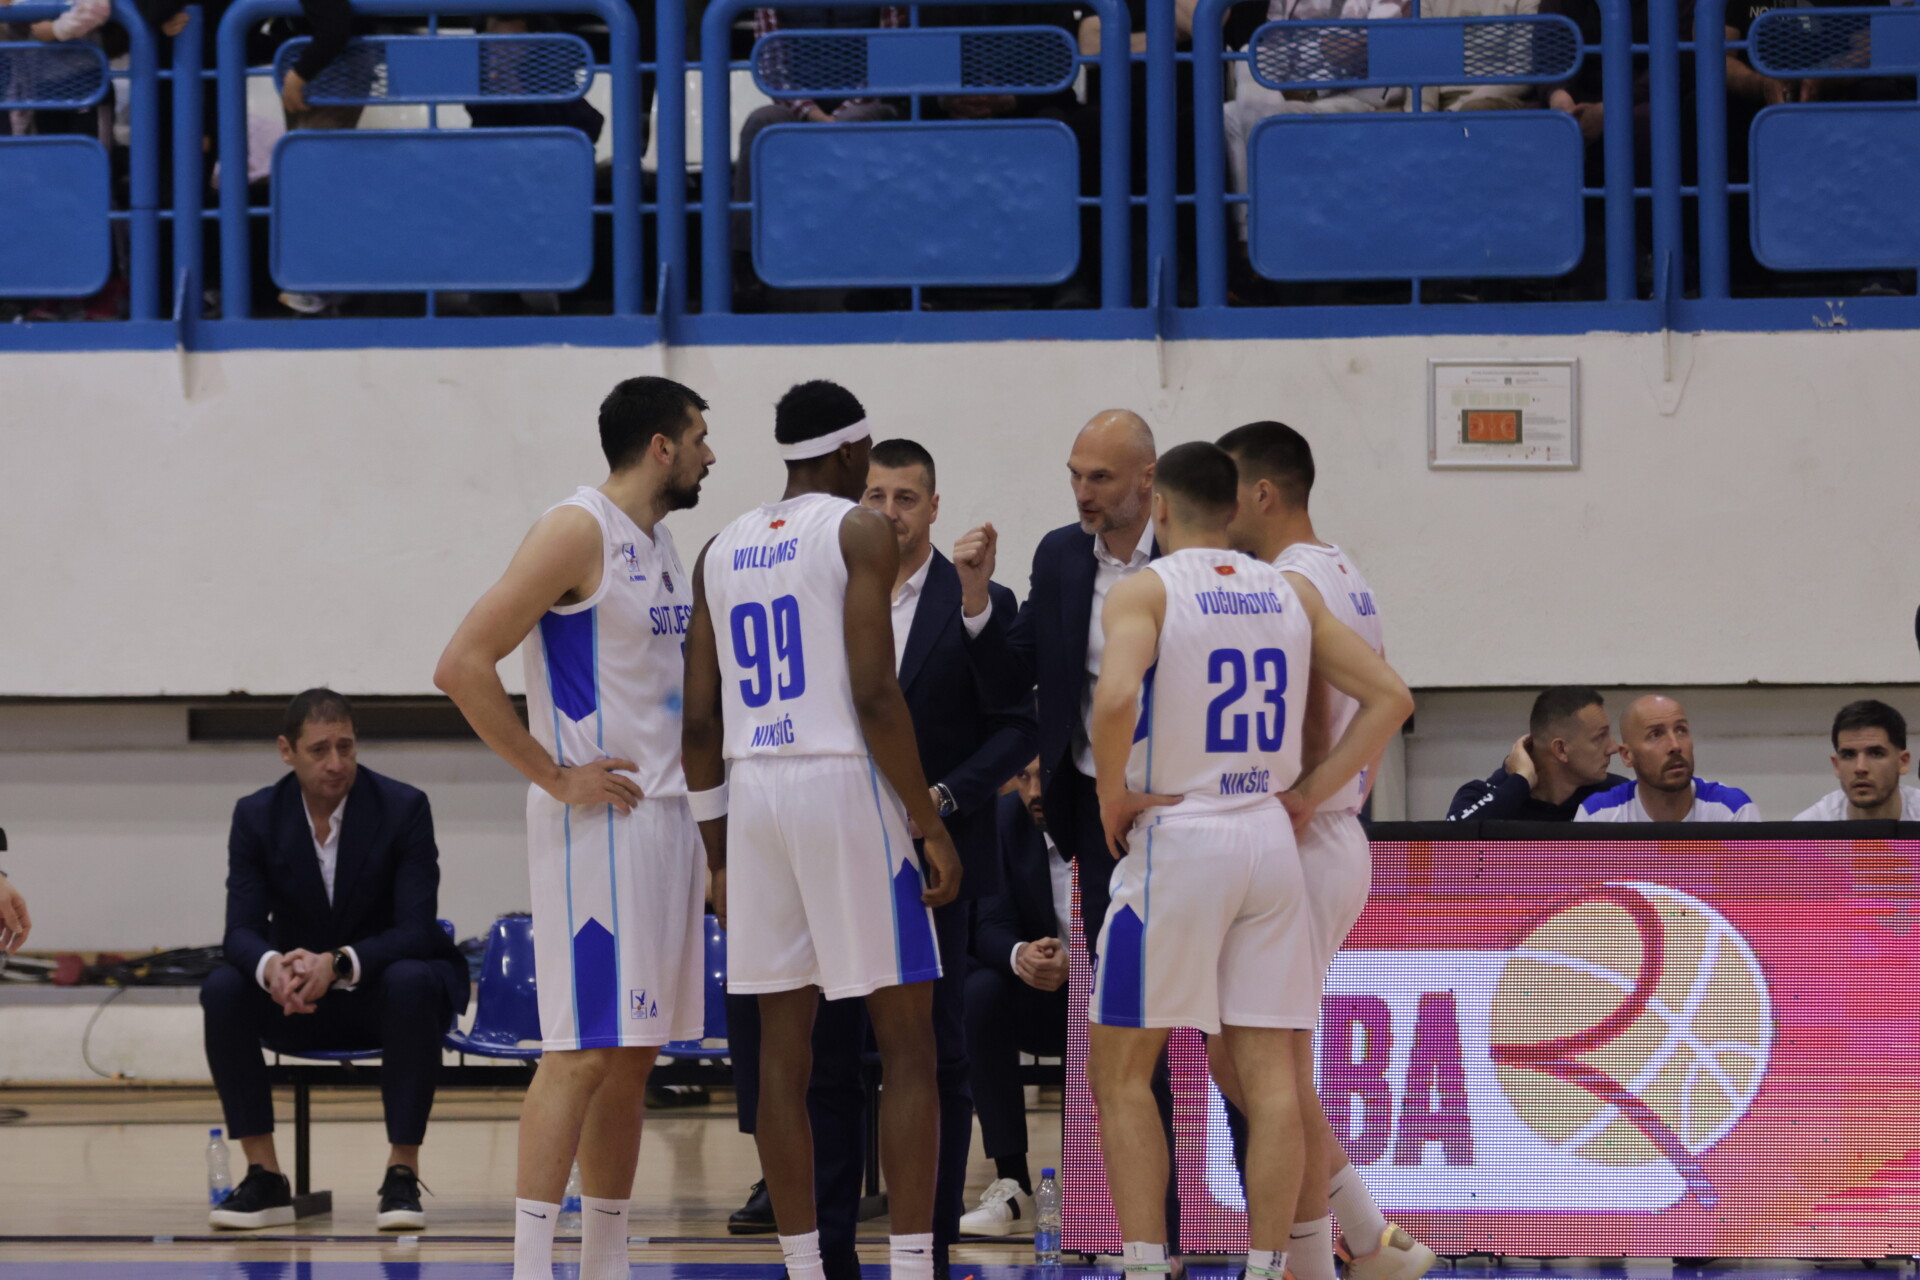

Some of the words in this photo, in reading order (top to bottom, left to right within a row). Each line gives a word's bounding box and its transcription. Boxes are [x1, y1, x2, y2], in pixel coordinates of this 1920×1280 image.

[650, 604, 693, 636] SUTJES
[730, 594, 806, 708] 99
[1205, 647, 1288, 753] 23
[1320, 991, 1474, 1166] BA
